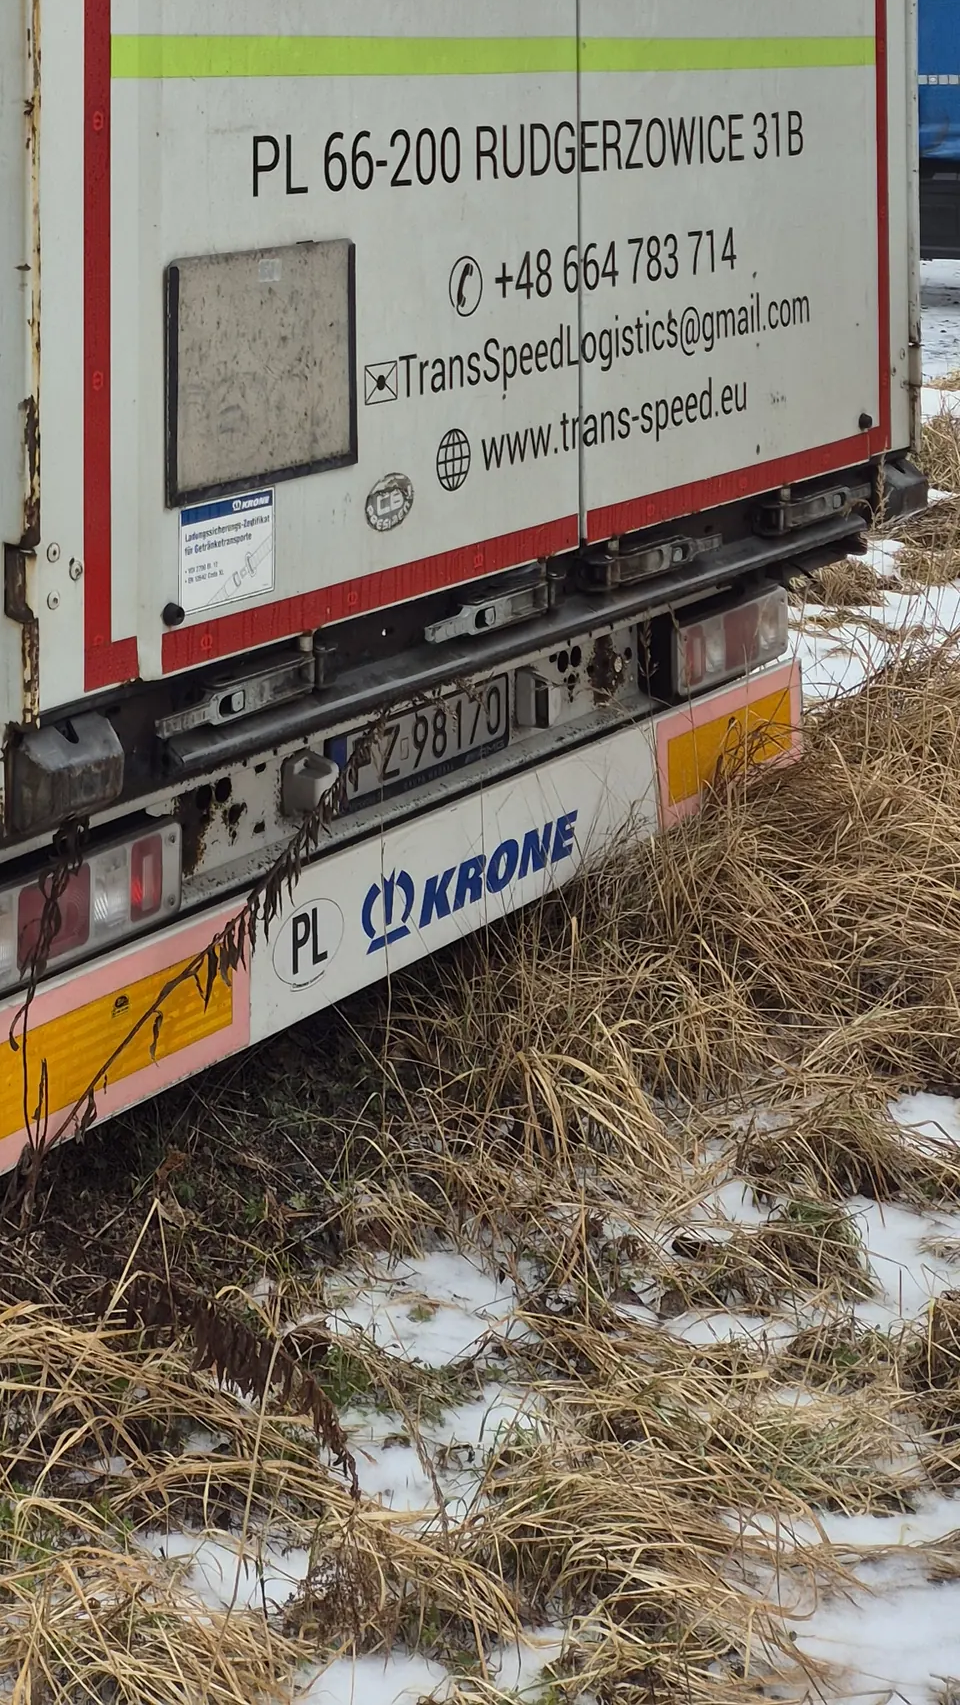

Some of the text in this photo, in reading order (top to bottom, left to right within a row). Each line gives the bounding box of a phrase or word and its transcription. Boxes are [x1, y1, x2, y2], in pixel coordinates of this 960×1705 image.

[252, 110, 804, 198] PL 66-200 RUDGERZOWICE 31B
[495, 226, 738, 300] +48 664 783 714
[399, 293, 811, 398] TransSpeedLogistics@gmail.com
[481, 377, 748, 472] www.trans-speed.eu
[412, 685, 502, 770] 98170
[418, 809, 579, 930] KRONE
[292, 906, 328, 976] PL
